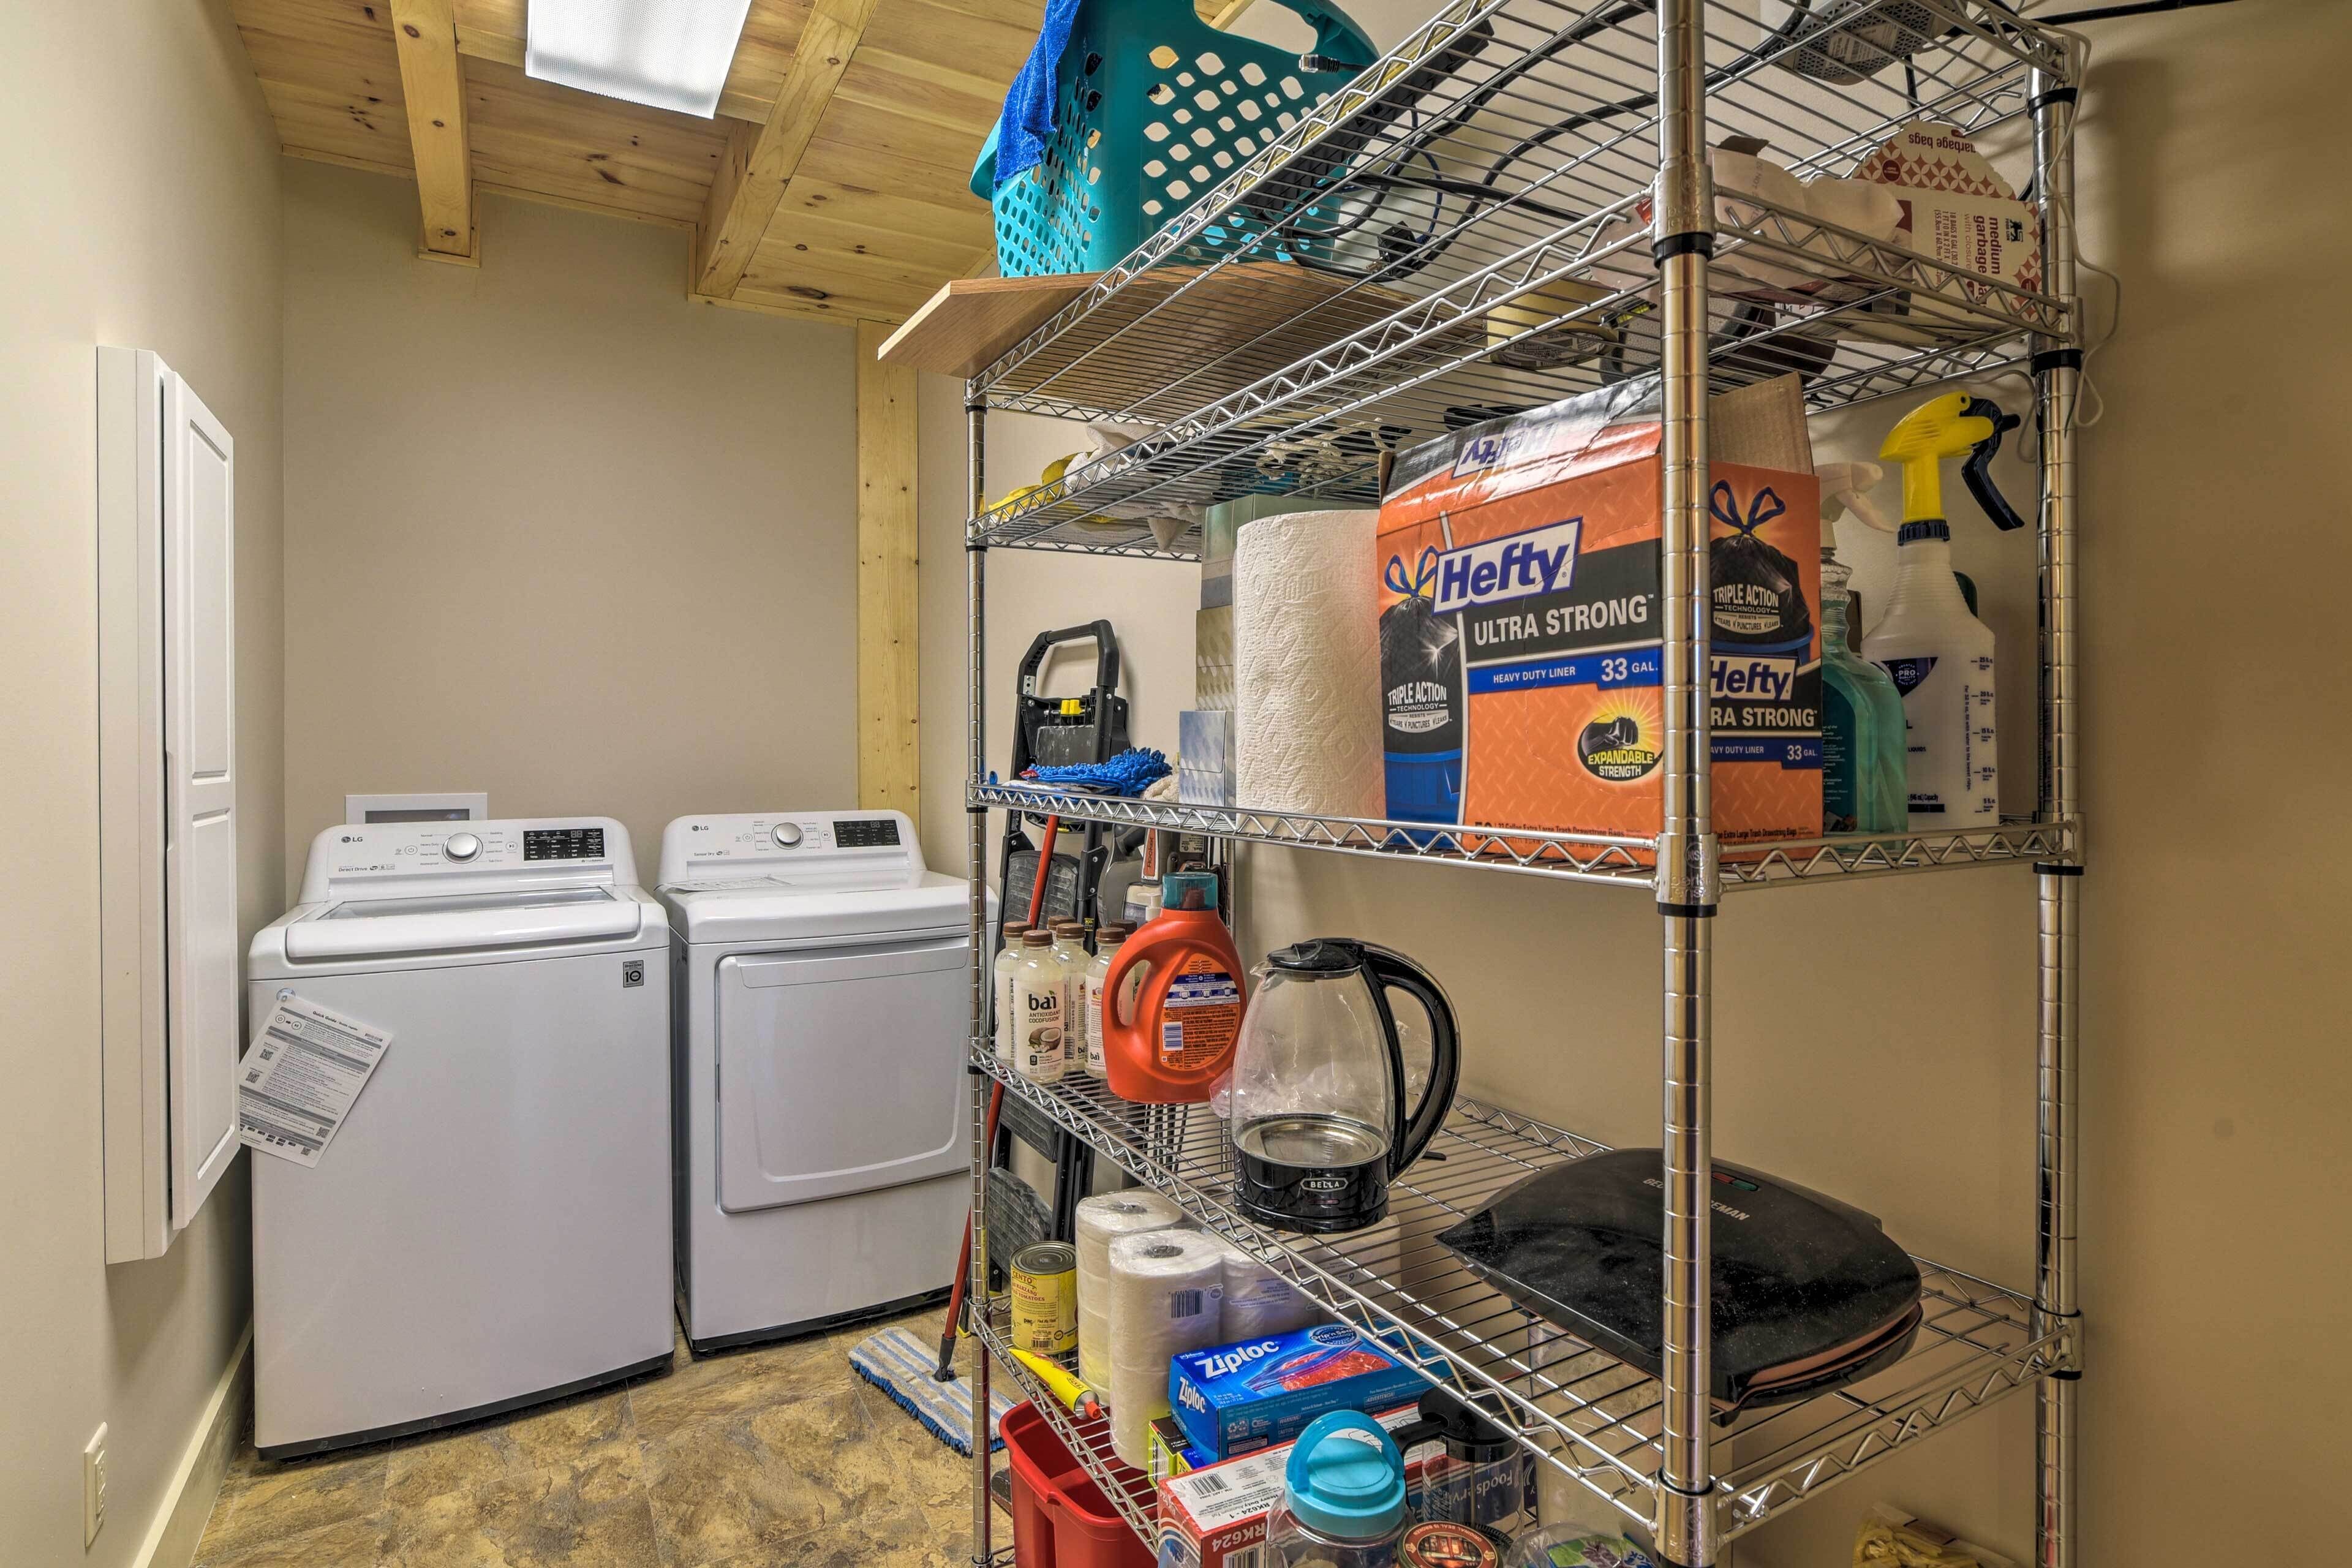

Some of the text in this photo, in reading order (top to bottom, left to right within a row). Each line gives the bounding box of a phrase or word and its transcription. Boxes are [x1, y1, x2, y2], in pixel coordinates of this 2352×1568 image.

[1909, 134, 1933, 148] bags
[1973, 215, 1988, 274] garbage
[1989, 217, 2002, 274] medium
[1441, 541, 1570, 603] Hefty
[1713, 583, 1779, 608] TRIPLE ACTION
[1724, 604, 1771, 614] TECHNOLOGY
[1474, 597, 1648, 646] ULTRA STRONG
[1718, 617, 1731, 626] TEARS
[1737, 621, 1762, 630] PUNCTURES
[1493, 657, 1659, 684] HEAVY DUTY LINER 33 GAL.
[1711, 660, 1791, 701] Hefty
[1387, 681, 1447, 706] TRIPLE ACTION
[1396, 703, 1439, 712] TECHNOLOGY
[1408, 720, 1430, 729] PUNCTURES
[1435, 715, 1447, 725] LEAKS
[1742, 707, 1815, 727] STRONG
[1588, 749, 1654, 766] EXPANDABLE
[1746, 745, 1764, 754] LINER
[1787, 745, 1802, 760] 33
[1599, 765, 1642, 777] STRENGTH
[1750, 829, 1762, 838] Trash
[1787, 827, 1797, 837] Bags
[625, 970, 641, 982] 10
[1012, 1271, 1033, 1284] CENTO
[1019, 1292, 1045, 1302] TOMATOES
[1194, 1341, 1279, 1379] Ziploc
[1178, 1376, 1205, 1414] Ziploc
[1245, 1500, 1260, 1509] Duty
[1261, 1494, 1278, 1502] Heavy
[1242, 1502, 1270, 1515] RK624
[1212, 1523, 1265, 1552] RK624
[1458, 1526, 1482, 1542] ORIGINAL
